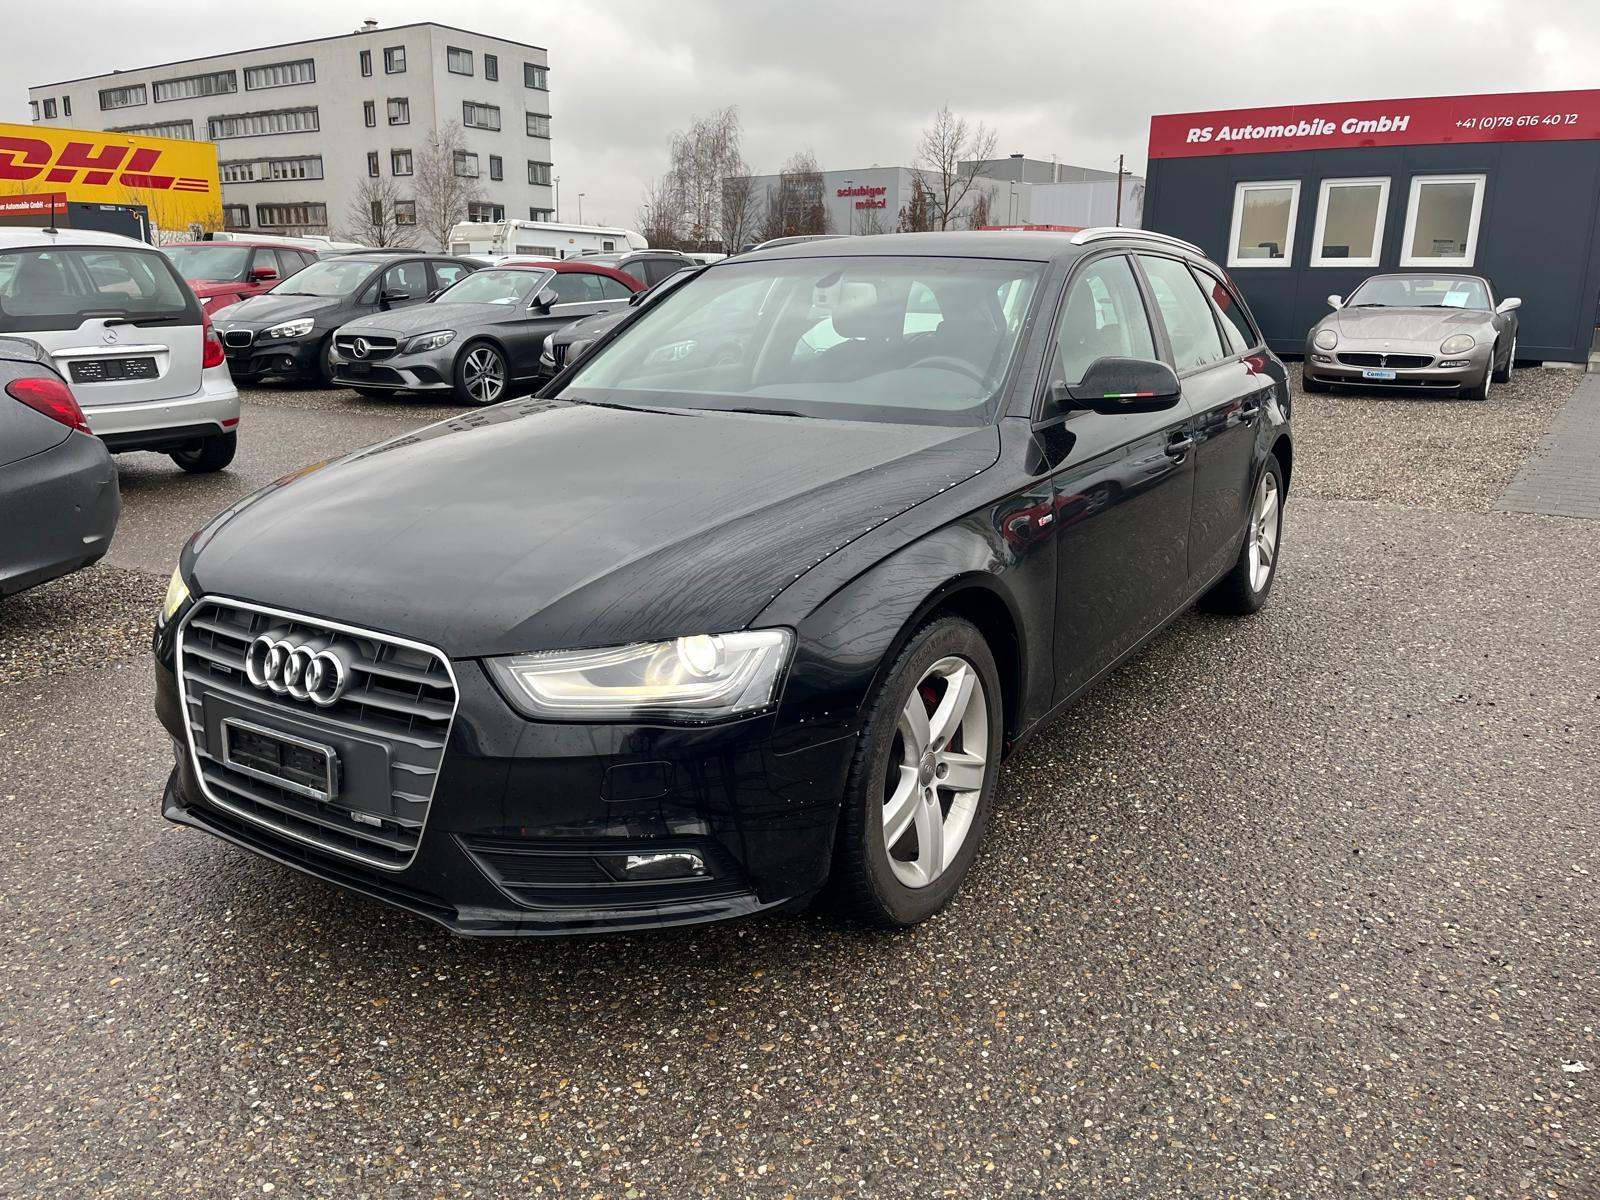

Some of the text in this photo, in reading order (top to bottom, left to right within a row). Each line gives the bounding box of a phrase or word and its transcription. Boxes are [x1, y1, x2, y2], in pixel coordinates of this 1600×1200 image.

[1186, 115, 1410, 143] RS Automobile GmbH
[1455, 113, 1578, 130] +41 (0)78 616 40 12
[0, 136, 175, 190] DHL
[837, 185, 887, 198] schubiger
